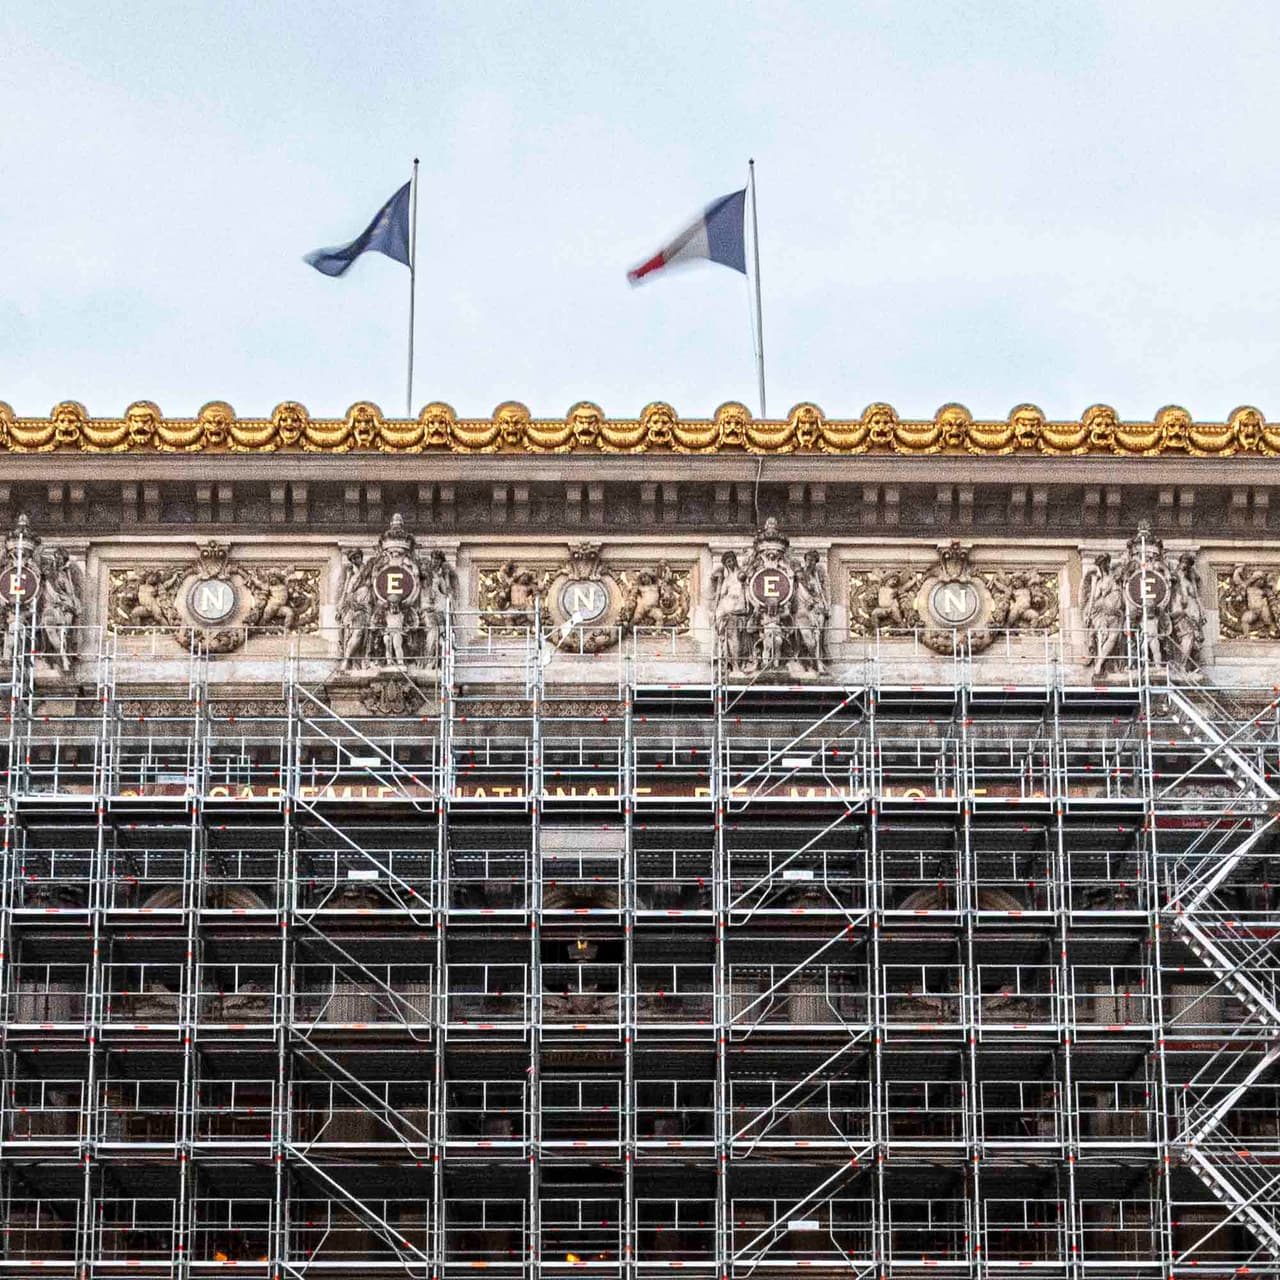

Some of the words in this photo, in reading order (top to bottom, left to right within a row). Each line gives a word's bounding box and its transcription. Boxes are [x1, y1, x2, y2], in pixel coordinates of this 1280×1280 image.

[9, 574, 26, 595] E
[387, 573, 404, 594] E
[763, 575, 780, 597] E
[1140, 578, 1157, 599] E
[202, 587, 224, 611] N
[574, 587, 595, 611] N
[943, 589, 966, 613] N
